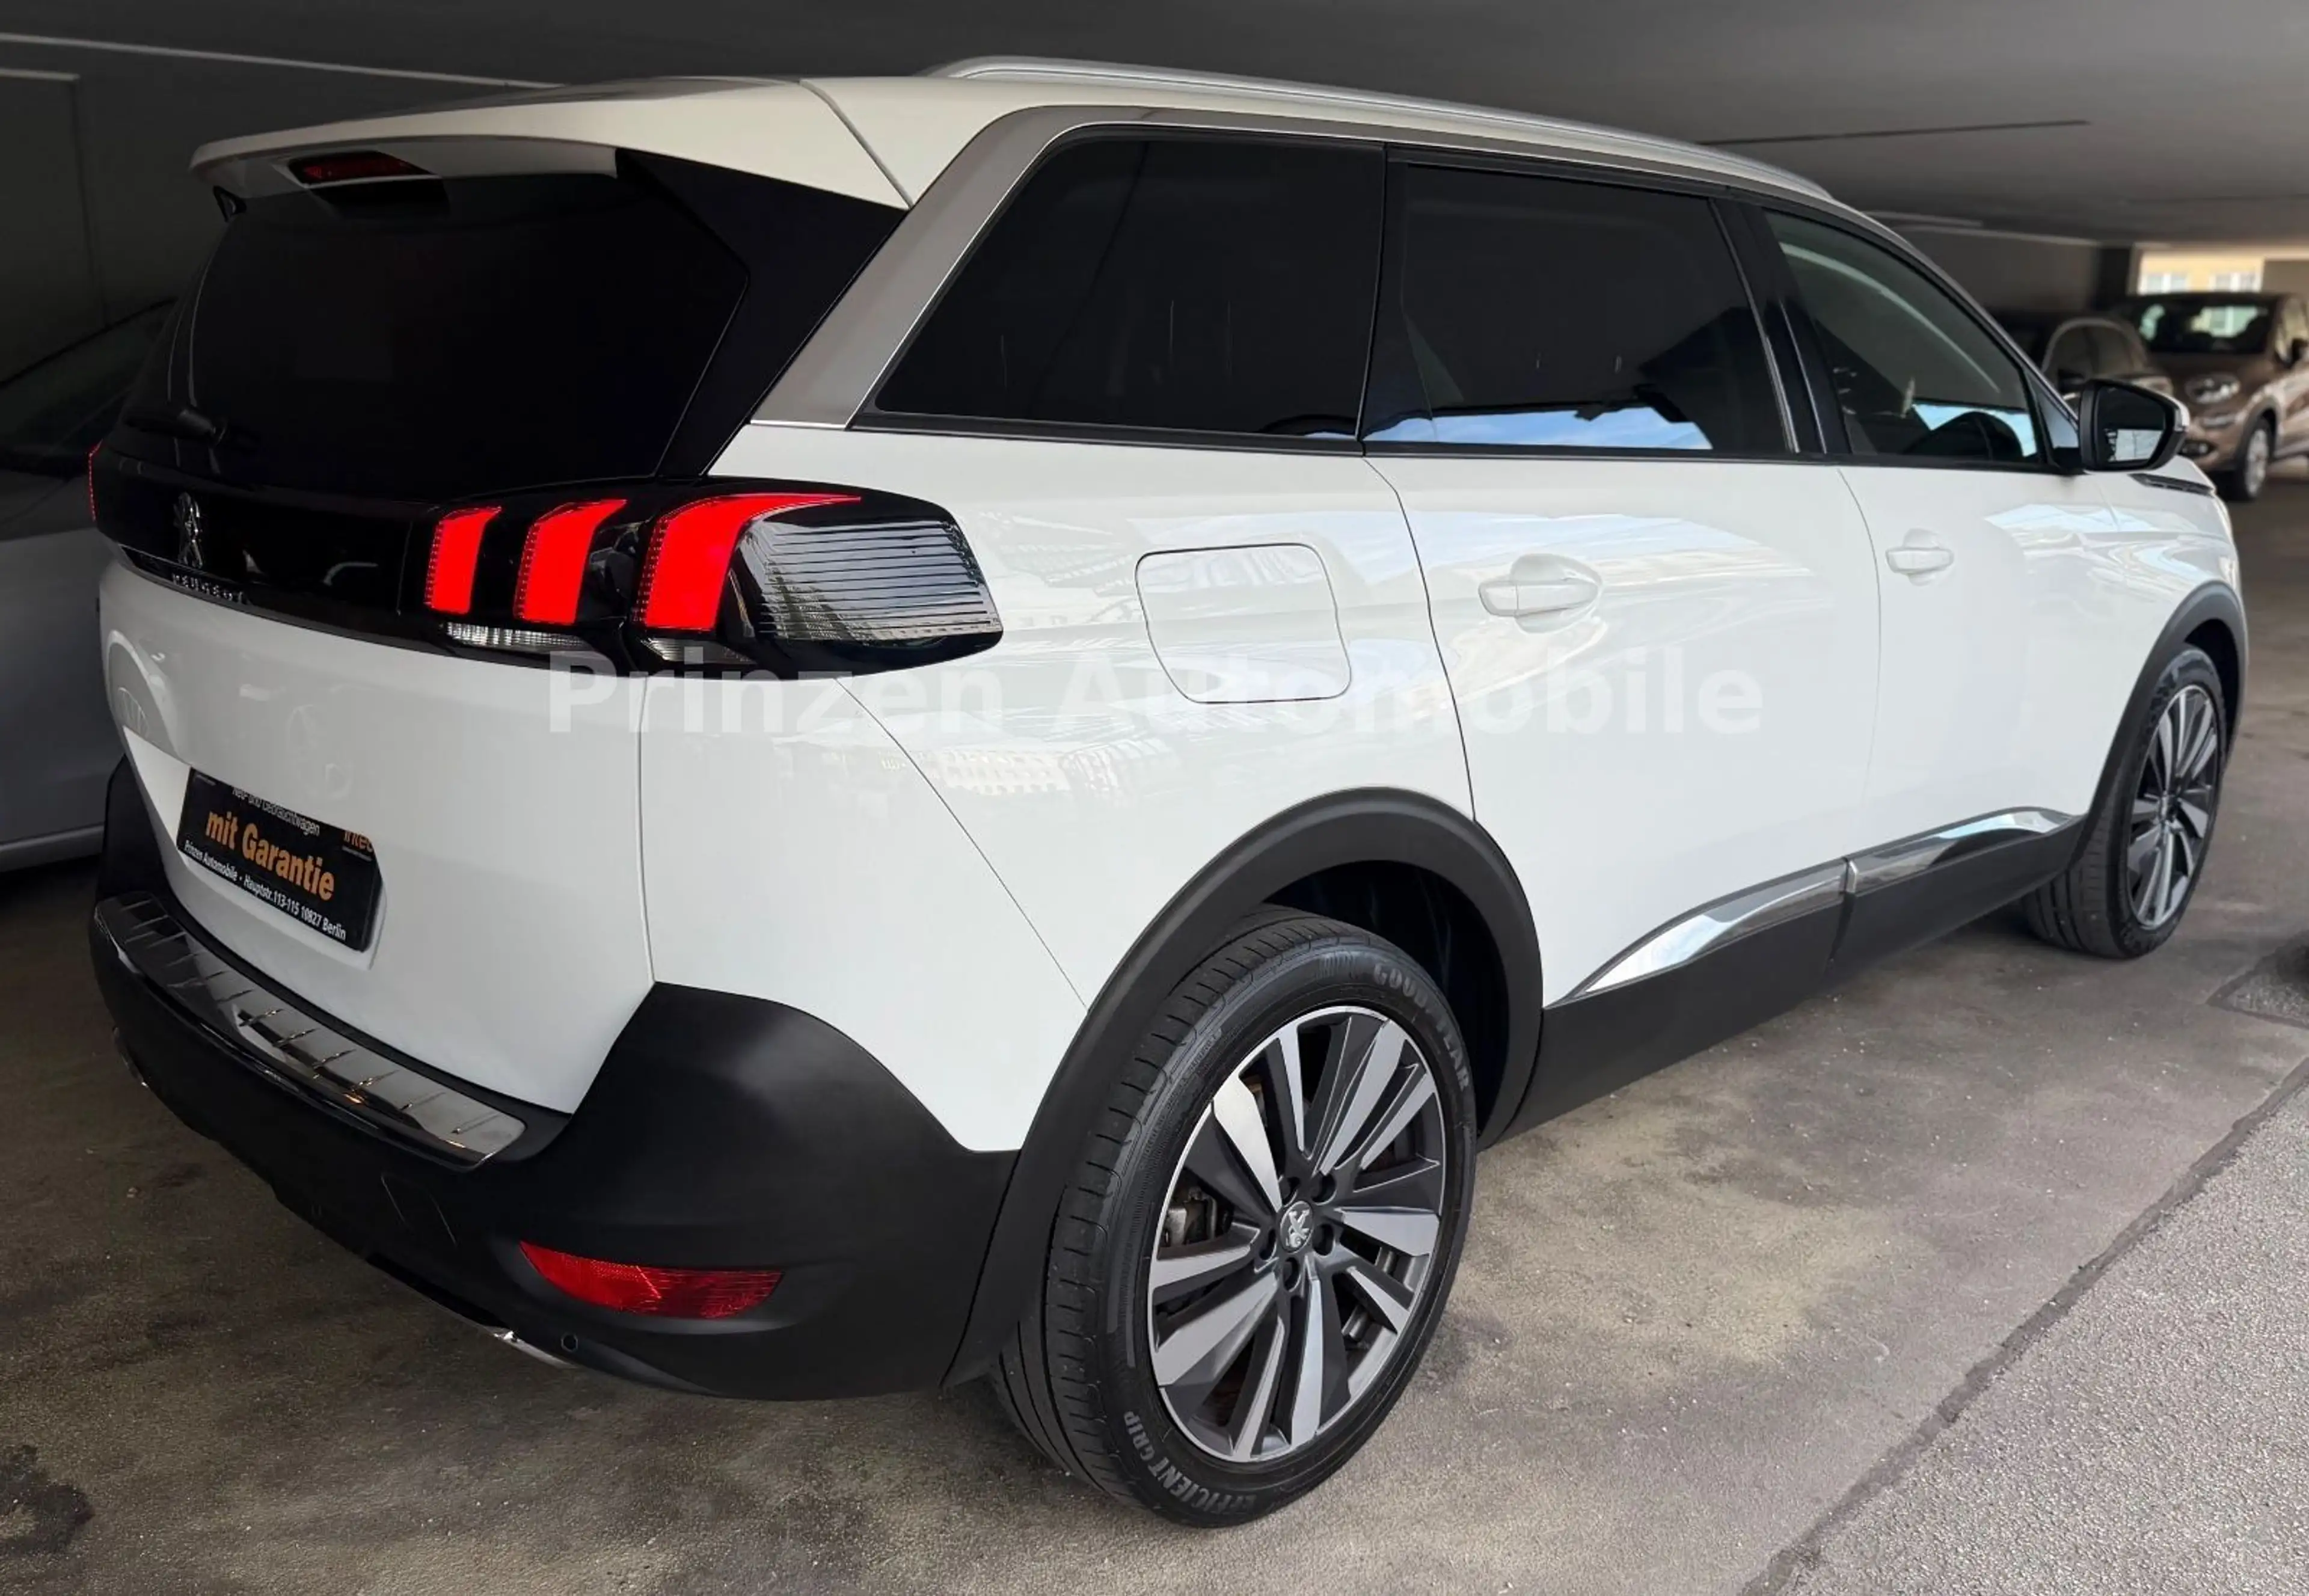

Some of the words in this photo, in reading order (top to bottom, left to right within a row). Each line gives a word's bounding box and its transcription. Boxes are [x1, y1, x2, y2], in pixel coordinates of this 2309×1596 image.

[184, 839, 203, 862] Prinzen
[203, 852, 238, 882] Automobile
[301, 905, 322, 927] 10827
[322, 916, 347, 942] Berlin
[205, 810, 238, 851] mit
[242, 823, 335, 901] Garantie
[1123, 1411, 1156, 1461] GRIP
